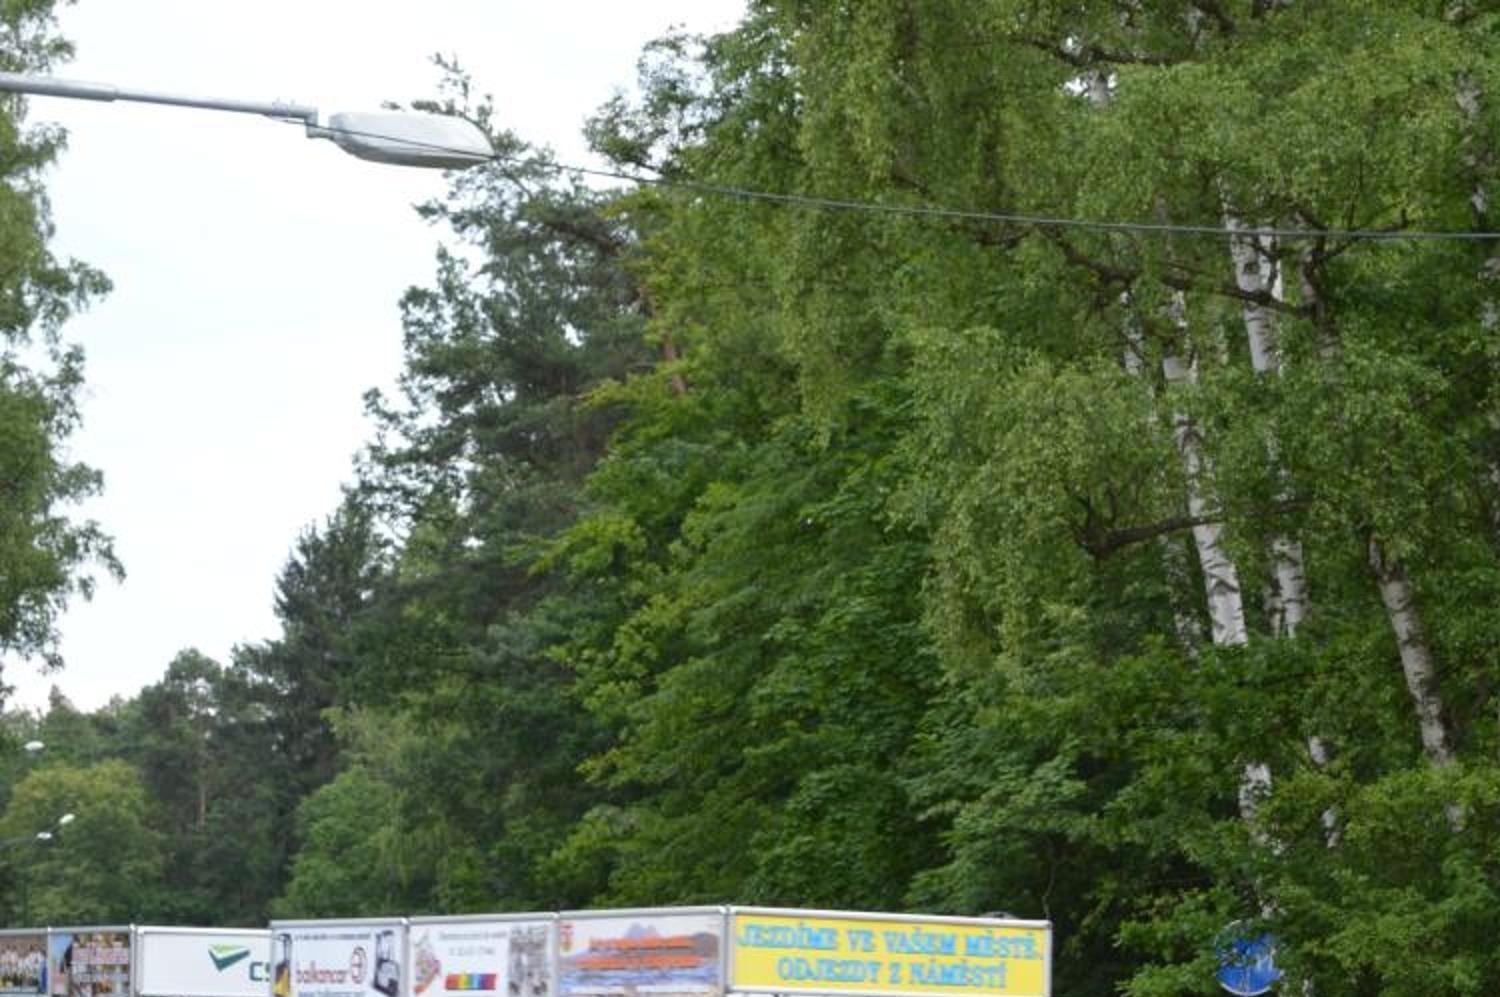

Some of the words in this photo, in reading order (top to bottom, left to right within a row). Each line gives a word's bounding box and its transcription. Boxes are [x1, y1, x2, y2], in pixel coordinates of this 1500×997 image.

[847, 928, 876, 952] VE
[883, 926, 957, 956] VAŠEM
[777, 957, 881, 984] ODJEZDY
[889, 962, 901, 985] Z
[909, 957, 1007, 988] NÁMĚSTÍ
